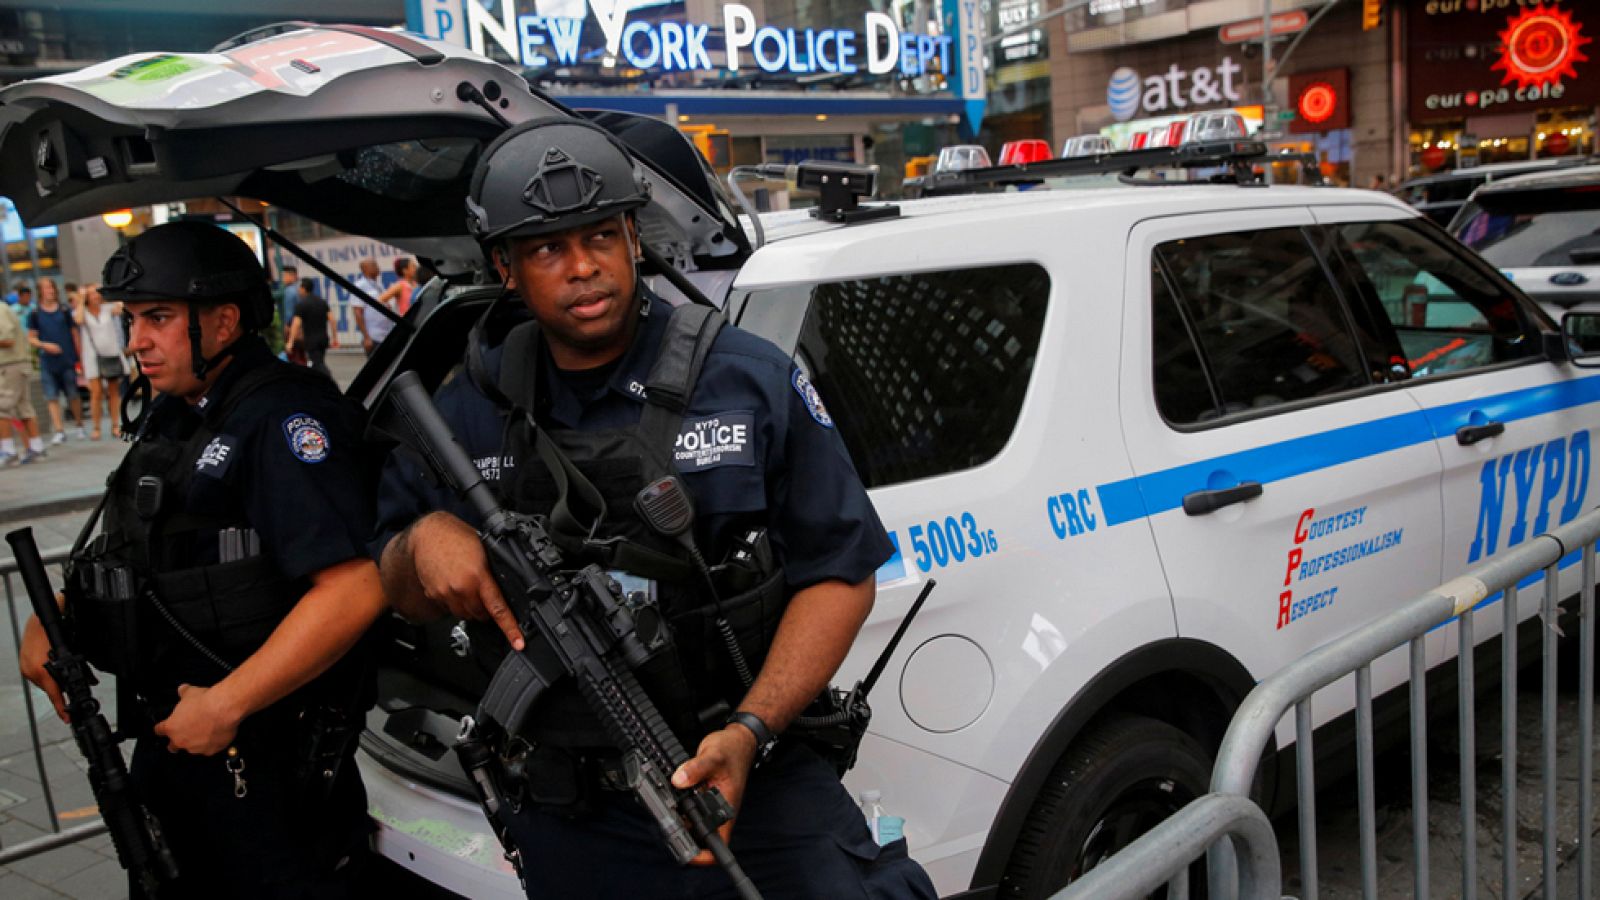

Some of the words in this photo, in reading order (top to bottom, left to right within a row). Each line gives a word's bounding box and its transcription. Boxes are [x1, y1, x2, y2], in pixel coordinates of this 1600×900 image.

[467, 0, 582, 67] NEW
[587, 0, 712, 70] YORK
[723, 4, 857, 73] POLICE
[866, 12, 952, 76] DEPT
[1142, 56, 1242, 112] at&t
[1047, 488, 1096, 540] CRC
[1294, 506, 1368, 545] COURTESY
[1468, 429, 1591, 564] NYPD
[908, 511, 982, 573] 5003
[1284, 527, 1404, 587] PROFESSIONALISM
[1276, 586, 1339, 631] RESPECT
